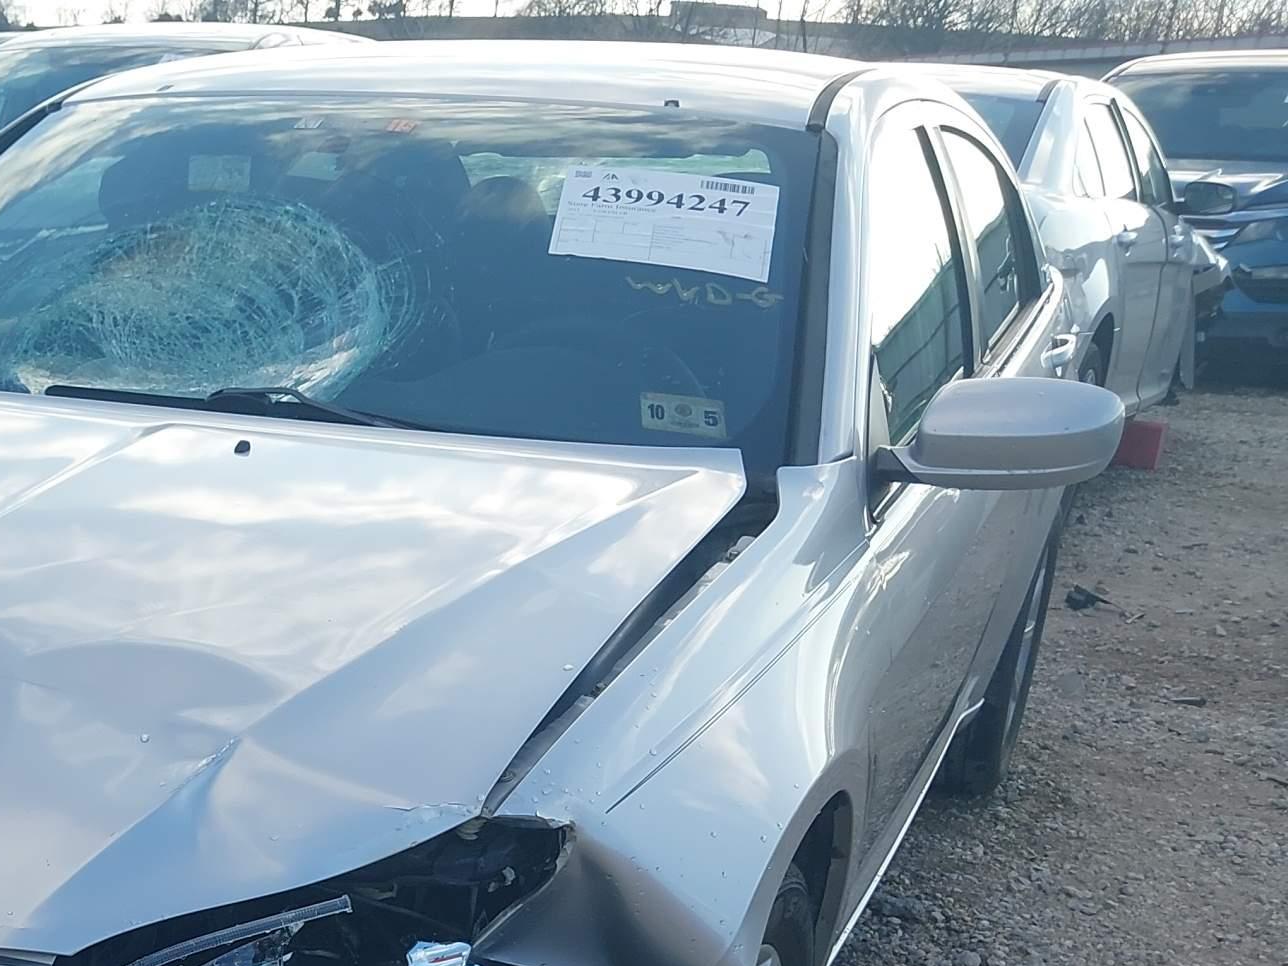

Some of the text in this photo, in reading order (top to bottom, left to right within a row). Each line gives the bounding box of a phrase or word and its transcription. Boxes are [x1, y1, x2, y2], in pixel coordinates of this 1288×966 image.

[581, 186, 751, 217] 43994247
[647, 403, 665, 420] 10
[703, 410, 719, 427] 5
